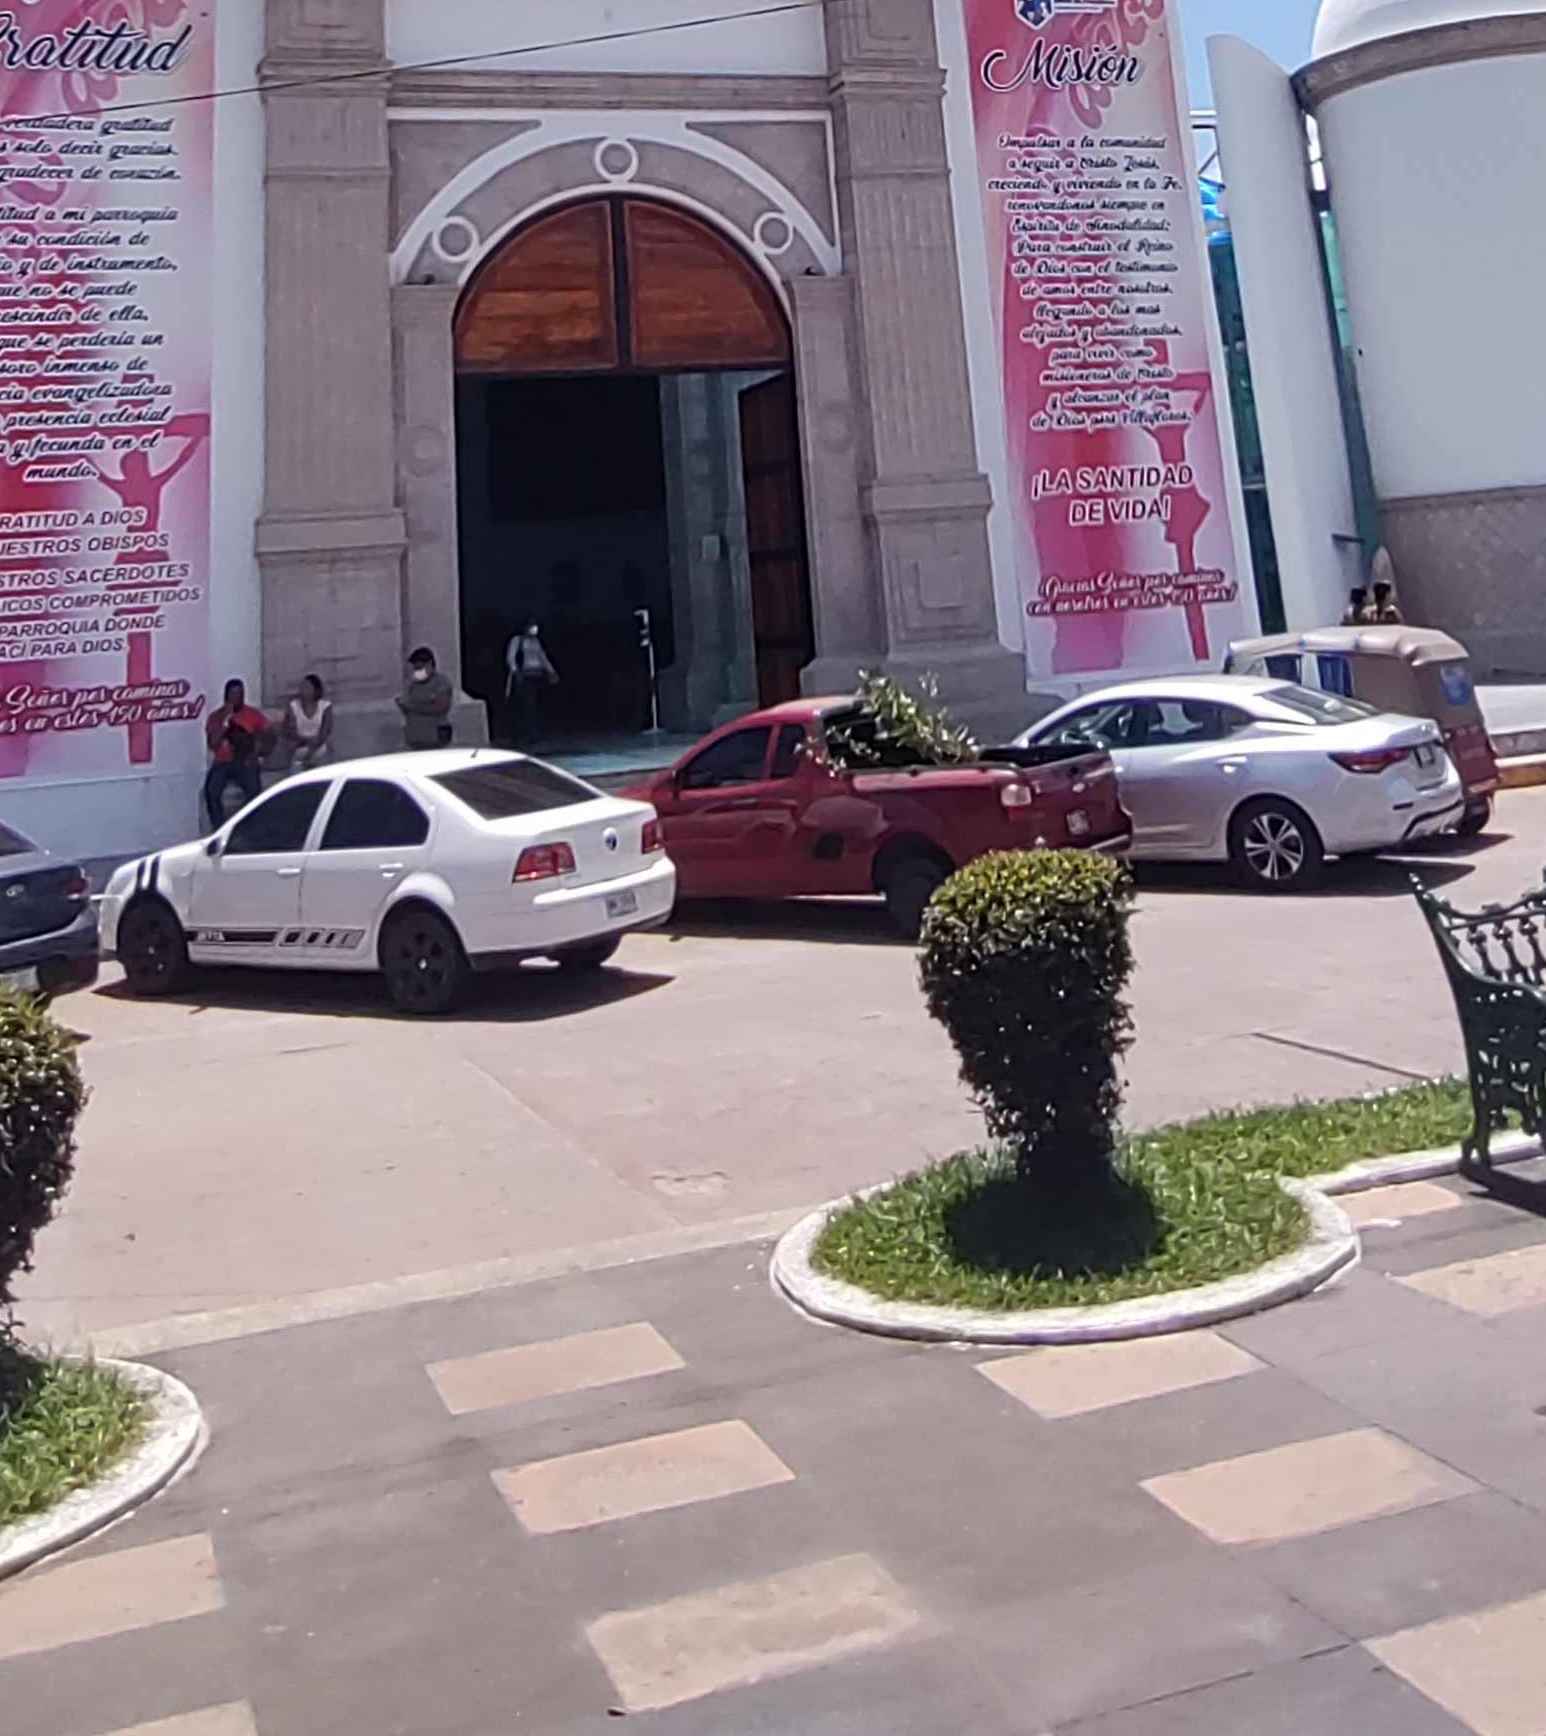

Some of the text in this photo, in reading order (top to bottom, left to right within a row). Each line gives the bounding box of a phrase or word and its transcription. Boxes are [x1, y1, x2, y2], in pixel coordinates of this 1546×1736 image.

[983, 38, 1137, 91] Misión
[13, 140, 51, 153] solo
[59, 140, 102, 154] decir
[81, 166, 101, 178] de
[45, 211, 55, 219] a
[63, 208, 85, 220] mi
[91, 207, 178, 223] parroquia
[6, 233, 27, 245] su
[37, 231, 120, 245] condición
[129, 231, 149, 245] de
[16, 260, 33, 278] y
[40, 257, 61, 270] de
[29, 285, 51, 295] no
[58, 285, 77, 295] se
[83, 282, 137, 301] puede
[81, 308, 101, 322] de
[33, 335, 52, 347] se
[58, 331, 134, 352] perdería
[142, 334, 164, 344] un
[44, 357, 118, 373] inmenso
[127, 356, 148, 371] de
[32, 383, 172, 404] evangelizadora
[5, 410, 91, 431] presencia
[100, 405, 171, 424] eclesial
[13, 442, 26, 462] y
[28, 435, 104, 457] fecunda
[112, 437, 132, 448] en
[141, 432, 163, 447] el
[1033, 470, 1071, 499] ¡LA
[83, 515, 95, 524] A
[101, 510, 145, 524] DIOS
[1109, 496, 1169, 520] VIDA!
[88, 534, 169, 550] OBISPOS
[64, 564, 188, 583] SACERDOTES
[50, 588, 200, 610] COMPROMETIDOS
[106, 615, 165, 632] DONDE
[30, 641, 76, 657] PARA
[6, 685, 68, 712] Señor
[76, 689, 106, 709] por
[25, 717, 45, 730] en
[54, 710, 99, 729] estos
[113, 705, 141, 725] 150
